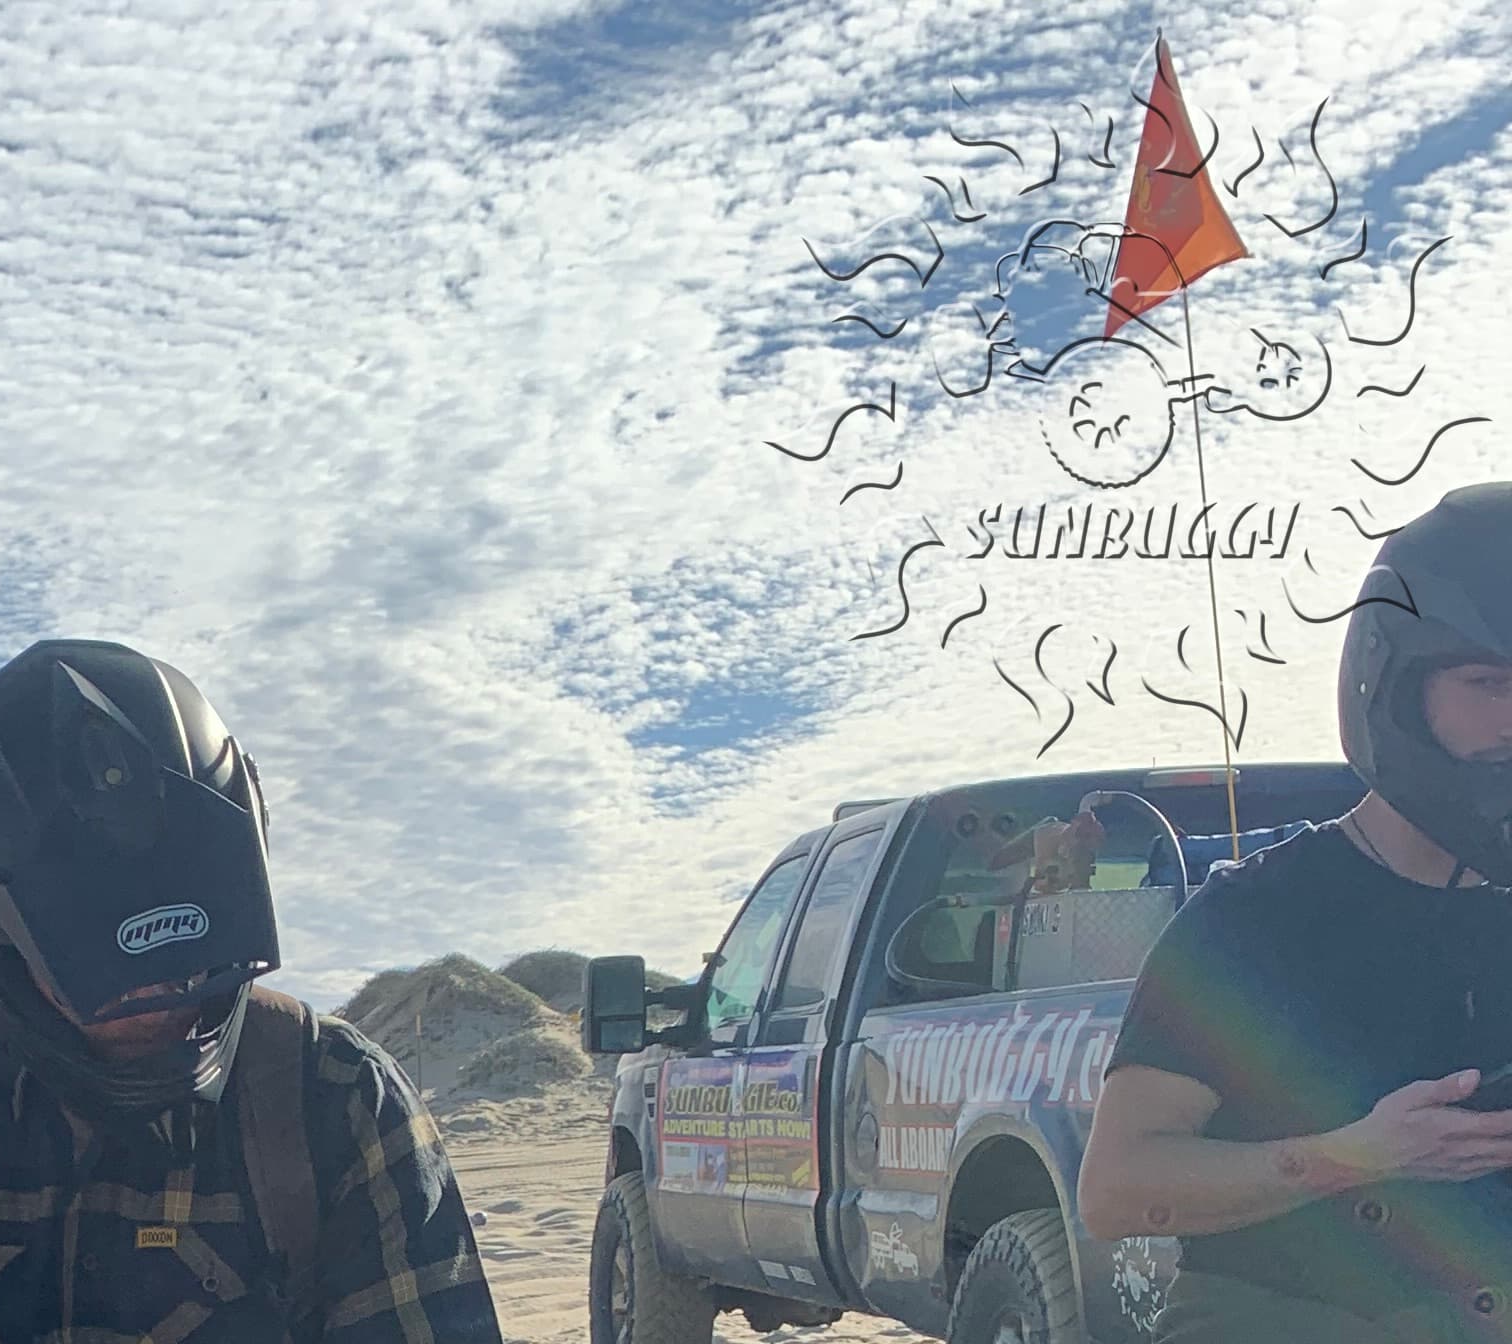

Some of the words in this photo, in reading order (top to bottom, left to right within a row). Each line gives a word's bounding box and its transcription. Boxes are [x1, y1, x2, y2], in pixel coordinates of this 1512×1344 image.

[663, 1119, 727, 1137] ADVENTURE
[728, 1119, 775, 1139] STARTS
[879, 1126, 900, 1169] ALL
